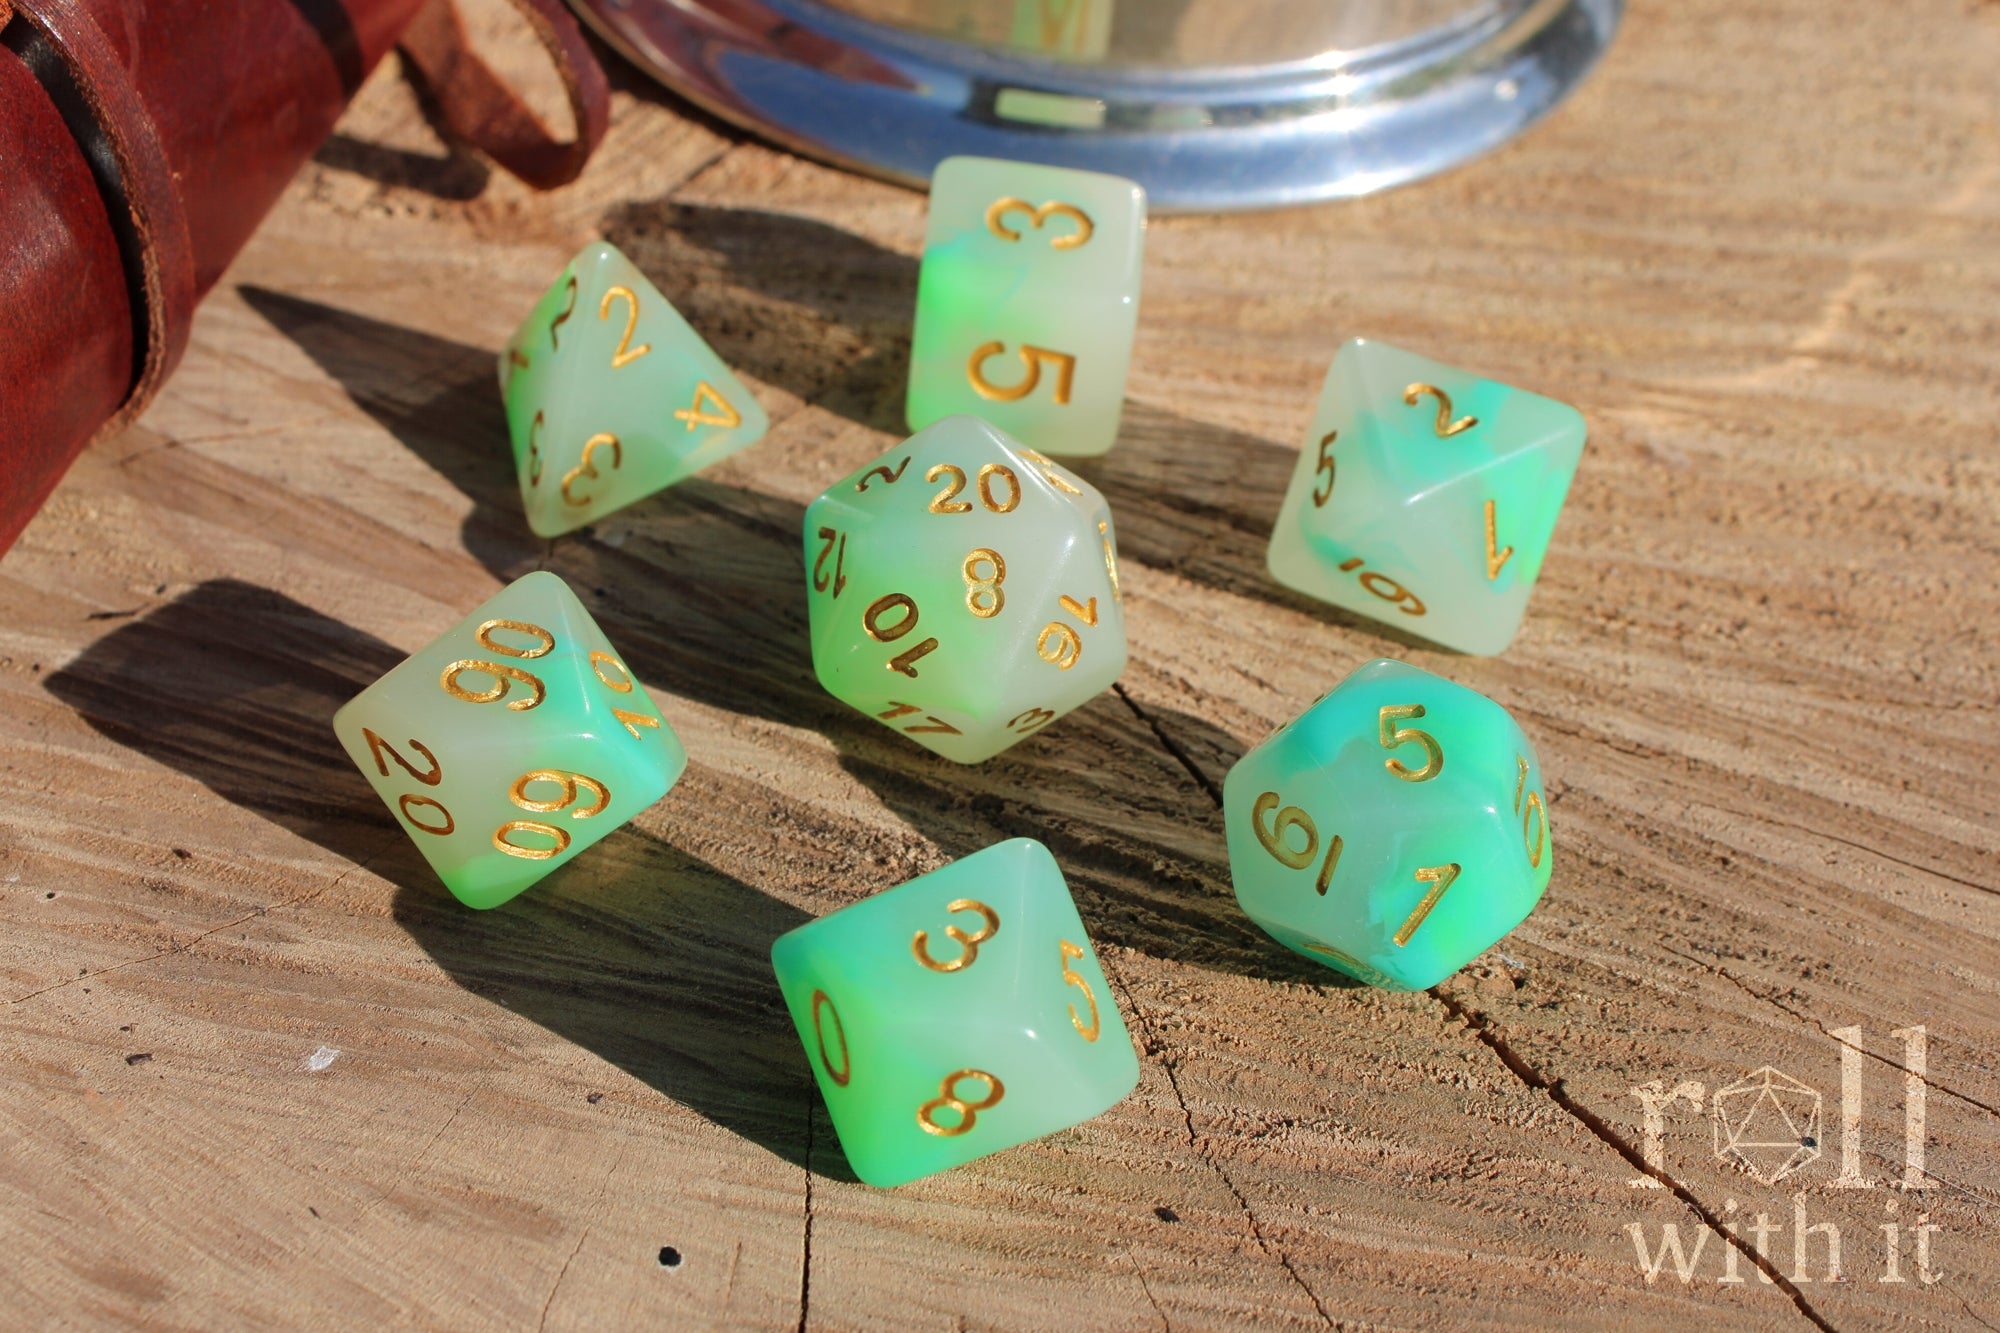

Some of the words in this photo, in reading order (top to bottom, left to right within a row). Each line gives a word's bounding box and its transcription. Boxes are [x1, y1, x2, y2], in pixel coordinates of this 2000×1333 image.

[985, 196, 1095, 252] 3
[600, 286, 651, 370] 2
[673, 379, 743, 433] 4
[966, 341, 1076, 406] 5
[1403, 382, 1478, 438] 2
[560, 432, 622, 508] 3
[855, 455, 912, 493] 2
[925, 463, 1022, 514] 20
[1312, 429, 1338, 508] 5
[813, 526, 847, 601] 12
[1484, 498, 1514, 581] 1
[961, 547, 1007, 619] 8
[862, 592, 939, 679] 10
[1036, 594, 1098, 671] 16
[589, 650, 660, 741] 10
[1006, 706, 1056, 734] 3
[1379, 703, 1444, 783] 5
[361, 727, 455, 836] 20
[1514, 752, 1546, 869] 10
[911, 898, 1000, 973] 3
[1060, 938, 1101, 1043] 5
[811, 988, 851, 1088] 0
[916, 1067, 1006, 1138] 8
